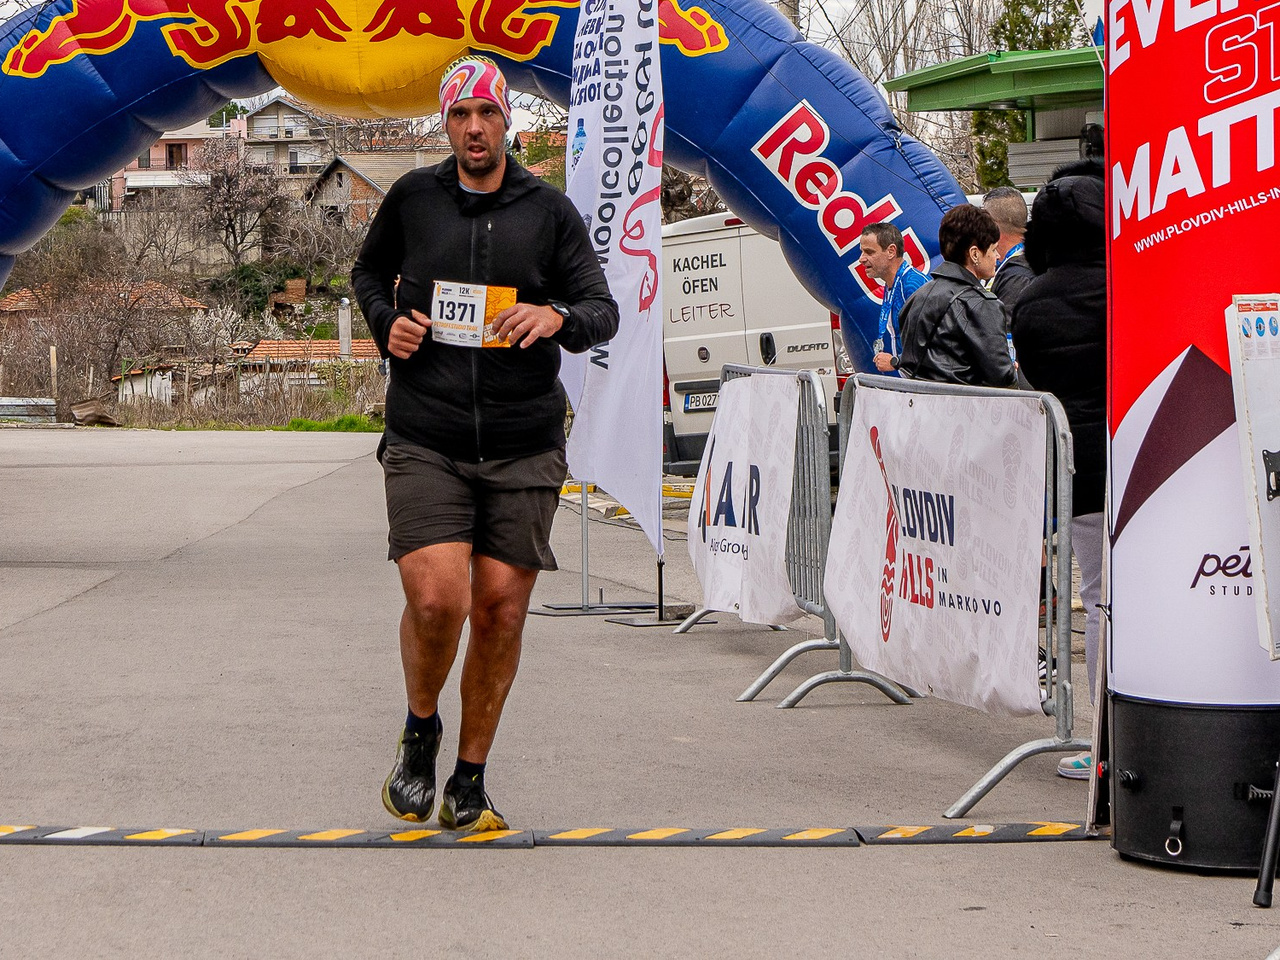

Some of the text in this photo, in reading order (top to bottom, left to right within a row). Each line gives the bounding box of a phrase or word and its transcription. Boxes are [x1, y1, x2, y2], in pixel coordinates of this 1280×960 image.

[753, 101, 900, 254] Red
[673, 253, 727, 273] KACHEL
[459, 286, 470, 295] 12K
[682, 277, 719, 295] ÖFEN
[438, 300, 476, 323] 1371
[669, 303, 735, 324] LEITER
[787, 342, 829, 354] DUCATO
[701, 393, 720, 407] 027
[892, 484, 955, 547] LOVDIV
[937, 566, 949, 584] IN
[938, 590, 1002, 617] MARKOVO
